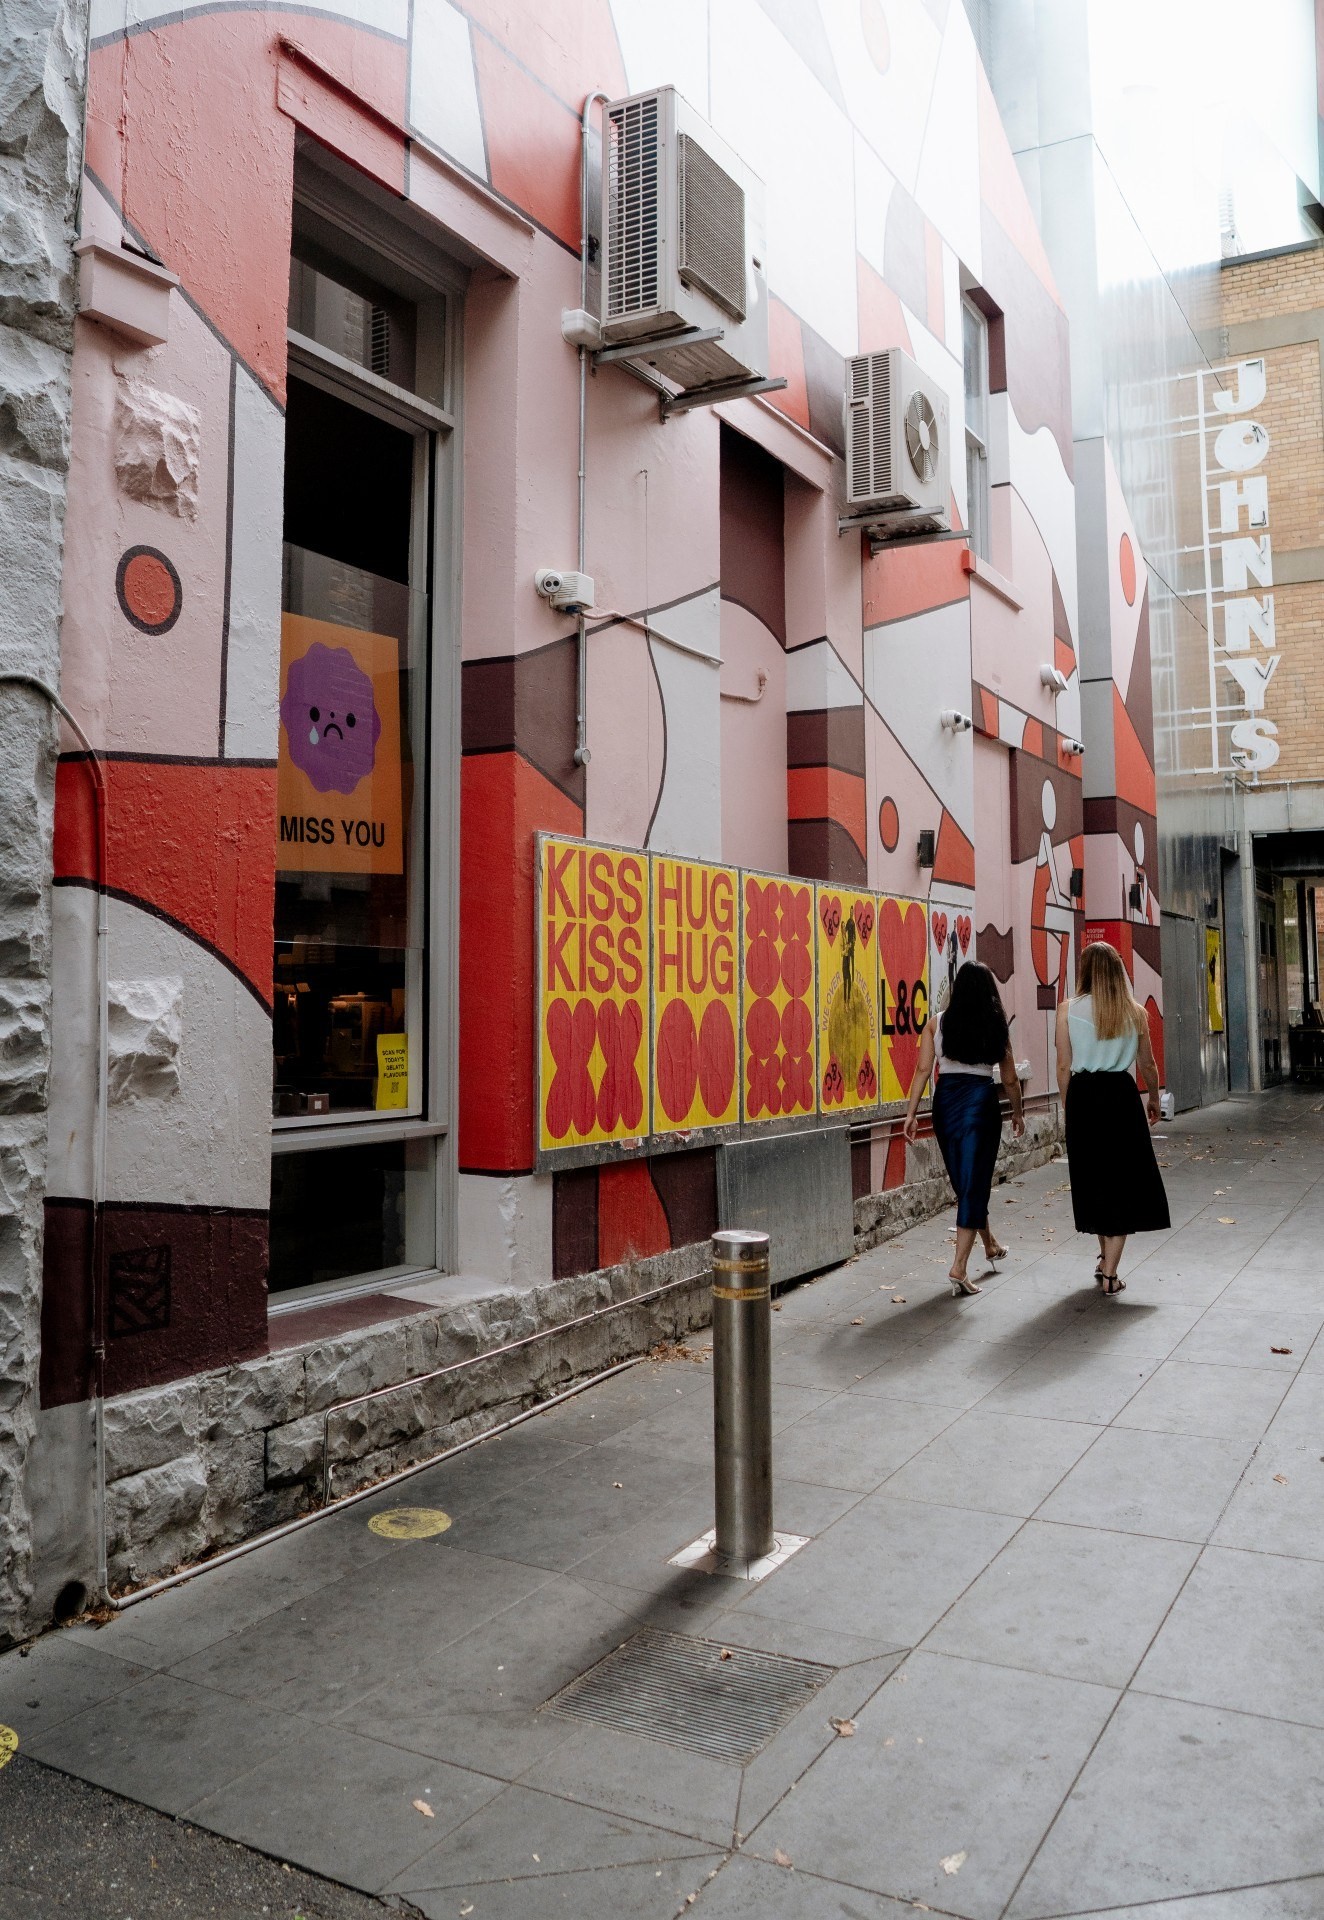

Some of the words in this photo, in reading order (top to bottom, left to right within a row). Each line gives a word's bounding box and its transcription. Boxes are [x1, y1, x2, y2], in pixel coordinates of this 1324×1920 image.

[1213, 358, 1281, 771] JOHNNYS
[280, 816, 334, 844] MISS
[341, 820, 385, 847] YOU
[547, 845, 643, 925] KISS
[658, 862, 733, 933] HUG
[822, 908, 840, 936] L&C
[856, 912, 873, 940] L&C
[547, 920, 643, 994] KISS
[658, 929, 734, 995] HUG
[822, 1009, 831, 1031] WE
[827, 971, 841, 1003] OVER
[855, 970, 867, 992] THE
[864, 990, 876, 1039] MOON
[881, 978, 928, 1036] L&C
